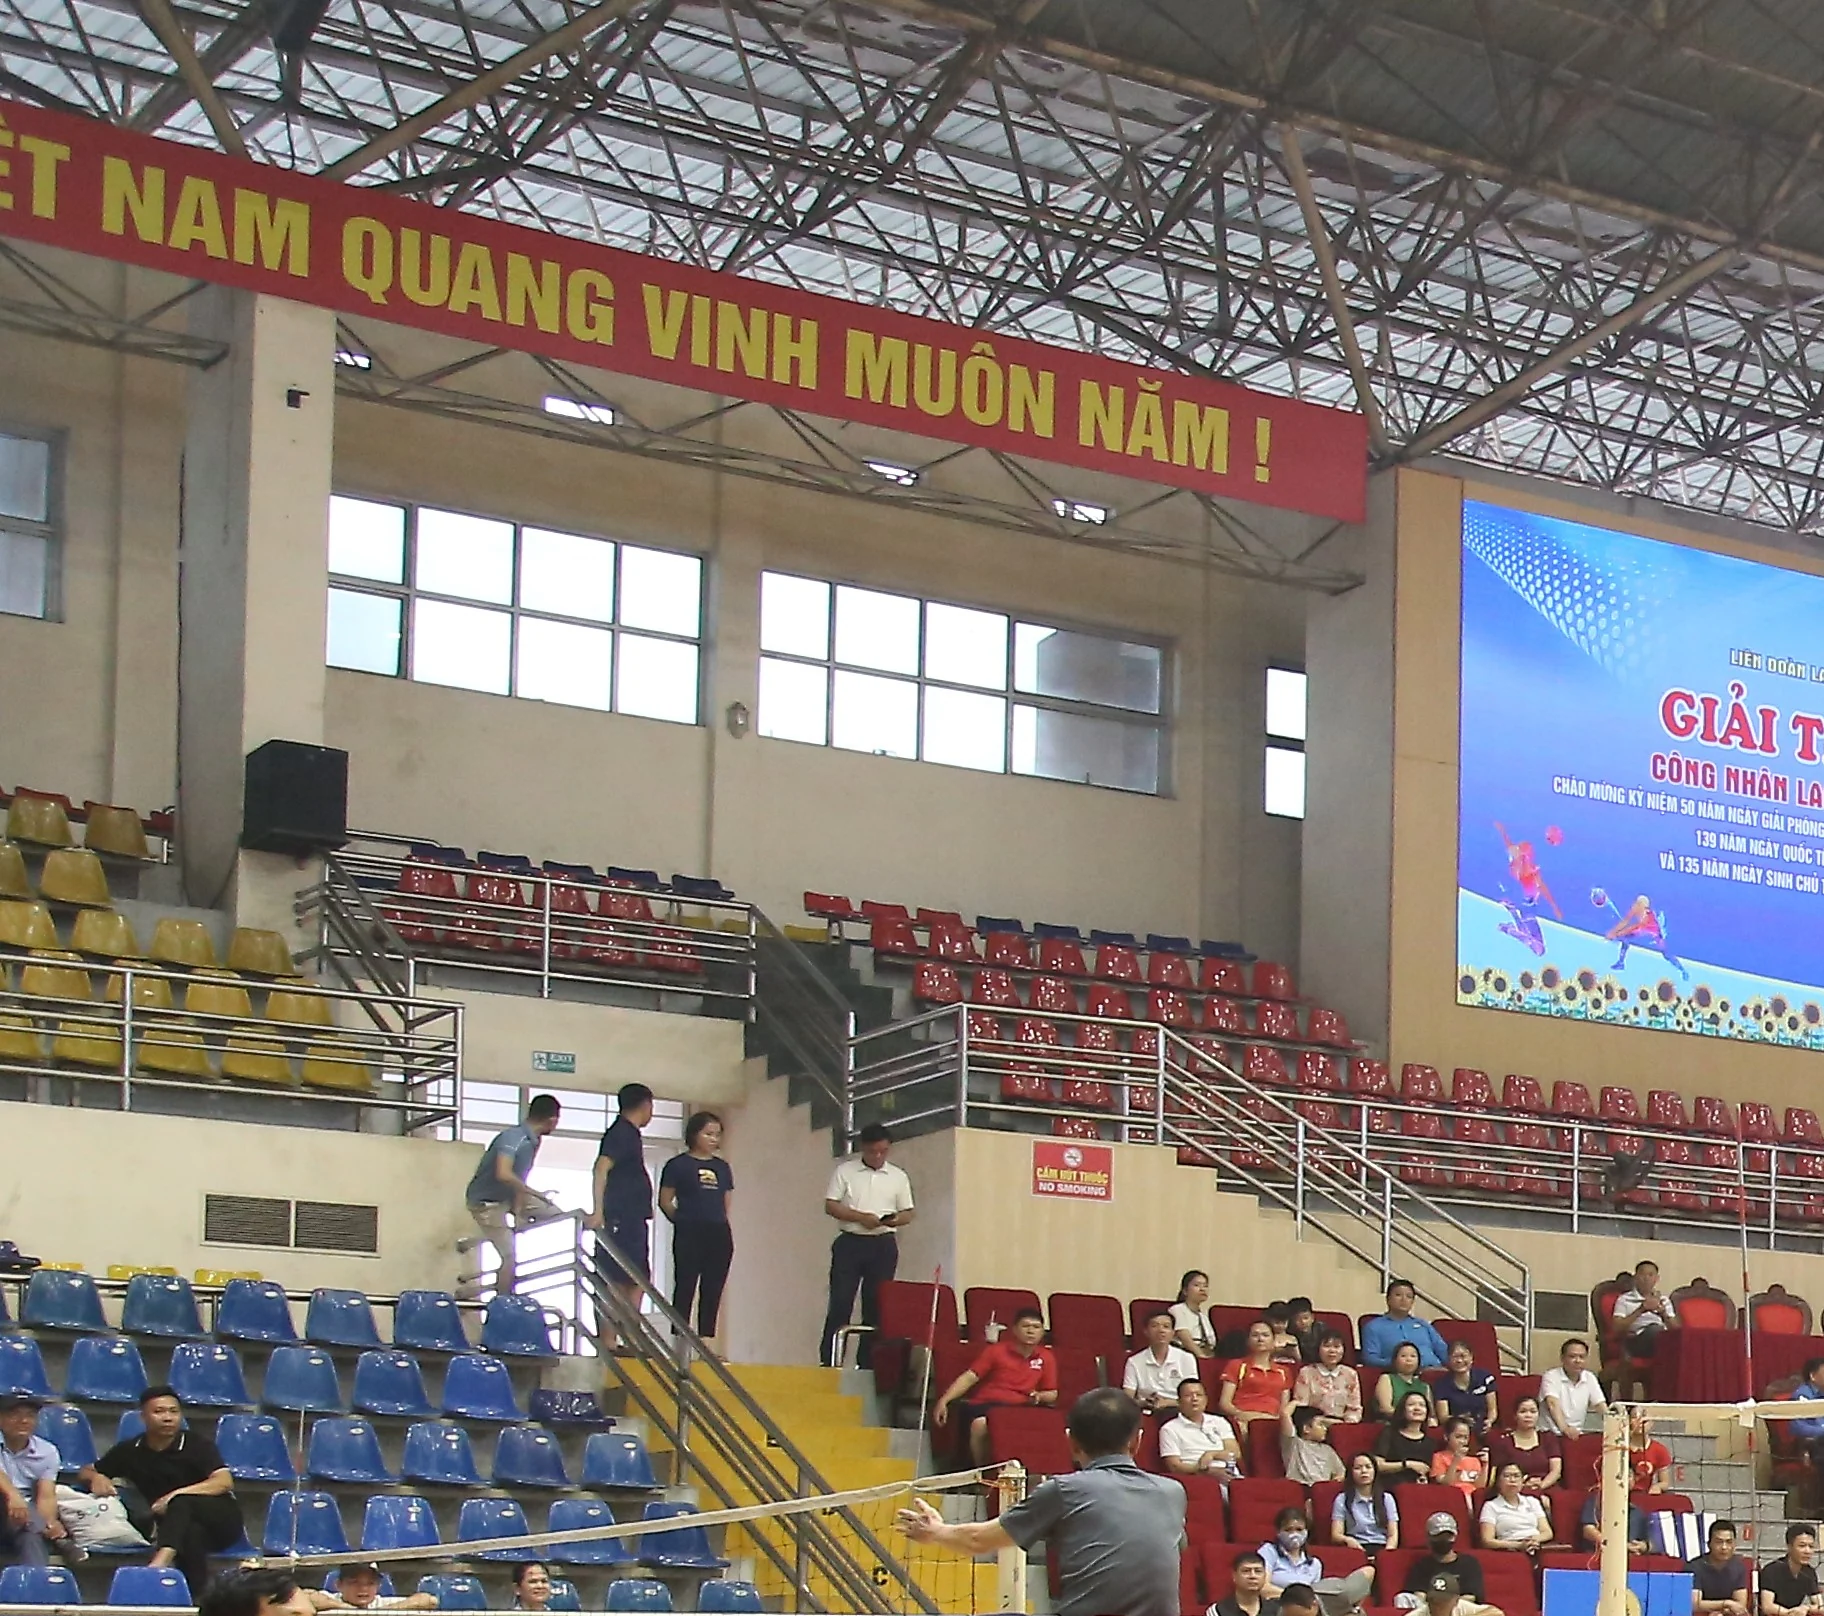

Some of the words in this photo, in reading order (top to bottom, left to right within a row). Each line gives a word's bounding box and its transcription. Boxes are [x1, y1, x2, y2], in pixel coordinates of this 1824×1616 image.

[102, 156, 310, 278] NAM
[342, 216, 615, 346] QUANG
[641, 283, 819, 390] VINH
[845, 341, 1056, 438] MUÔN
[1079, 377, 1229, 474] NĂM
[1254, 417, 1271, 483] !
[1730, 648, 1762, 671] LIÊN
[1767, 654, 1806, 680] ĐOÀN
[1661, 681, 1778, 755] GIẢI
[1651, 750, 1717, 791] CÔNG
[1724, 764, 1789, 802] NHÂN
[1553, 774, 1586, 797] CHÀO
[1589, 780, 1625, 805] MỪNG
[1646, 790, 1678, 816] NIỆM
[1680, 798, 1696, 818] 50
[1698, 799, 1726, 822] NĂM
[1728, 804, 1760, 828] NGÀY
[1761, 810, 1785, 833] GIẢI
[1696, 829, 1717, 850] 139
[1720, 832, 1747, 854] NĂM
[1749, 837, 1780, 860] NGÀY
[1782, 841, 1814, 866] QUỐC
[1660, 850, 1677, 872] VÀ
[1679, 855, 1700, 875] 135
[1702, 858, 1730, 880] NĂM
[1732, 863, 1764, 885] NGÀY
[1766, 869, 1793, 891] SINH
[1795, 872, 1820, 895] CHỦ
[1038, 1182, 1055, 1193] NO
[1056, 1183, 1106, 1197] SMOKING
